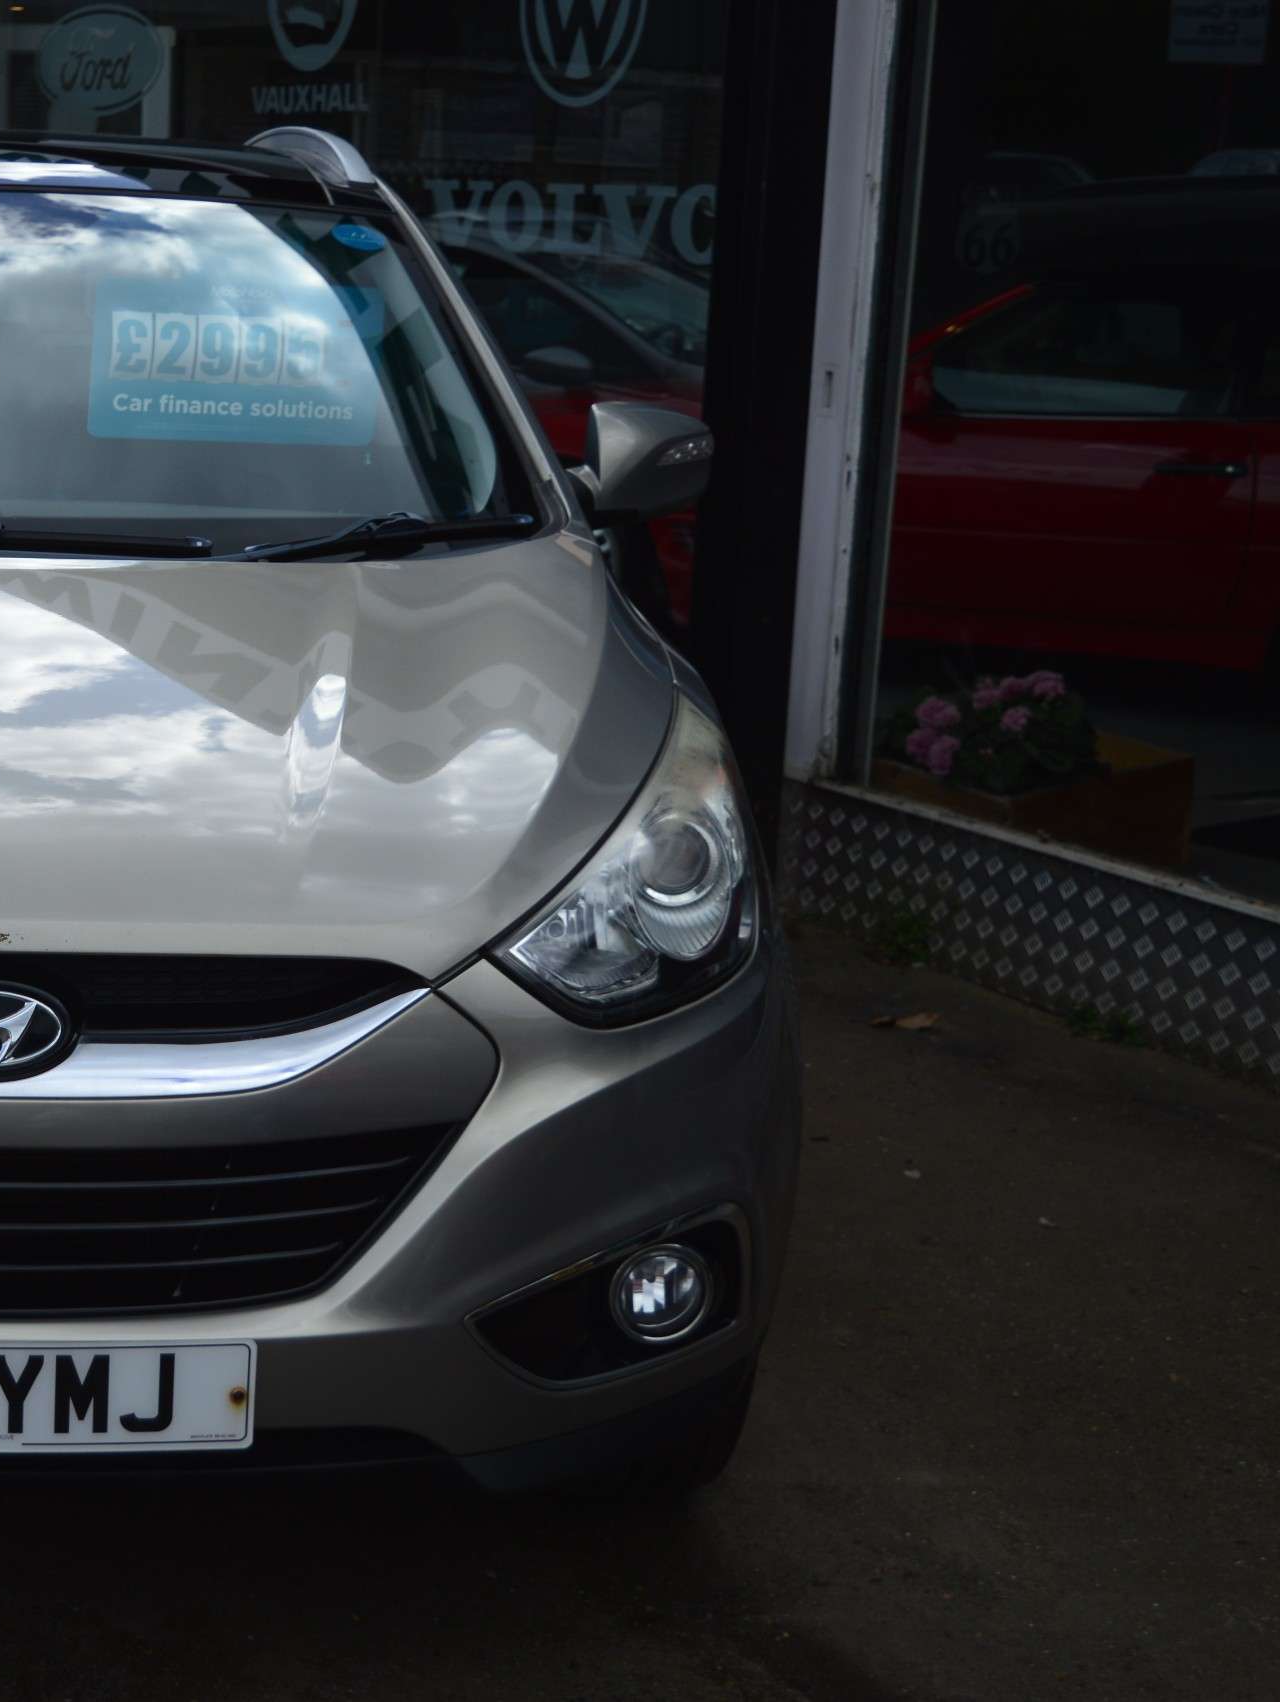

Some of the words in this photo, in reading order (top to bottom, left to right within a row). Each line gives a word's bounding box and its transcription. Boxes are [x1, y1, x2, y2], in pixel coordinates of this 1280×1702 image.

[60, 29, 136, 92] Ford
[251, 83, 370, 114] VAUXHALL
[116, 318, 322, 380] £2995
[113, 393, 153, 412] Car
[160, 394, 243, 416] finance
[250, 399, 354, 420] solutions
